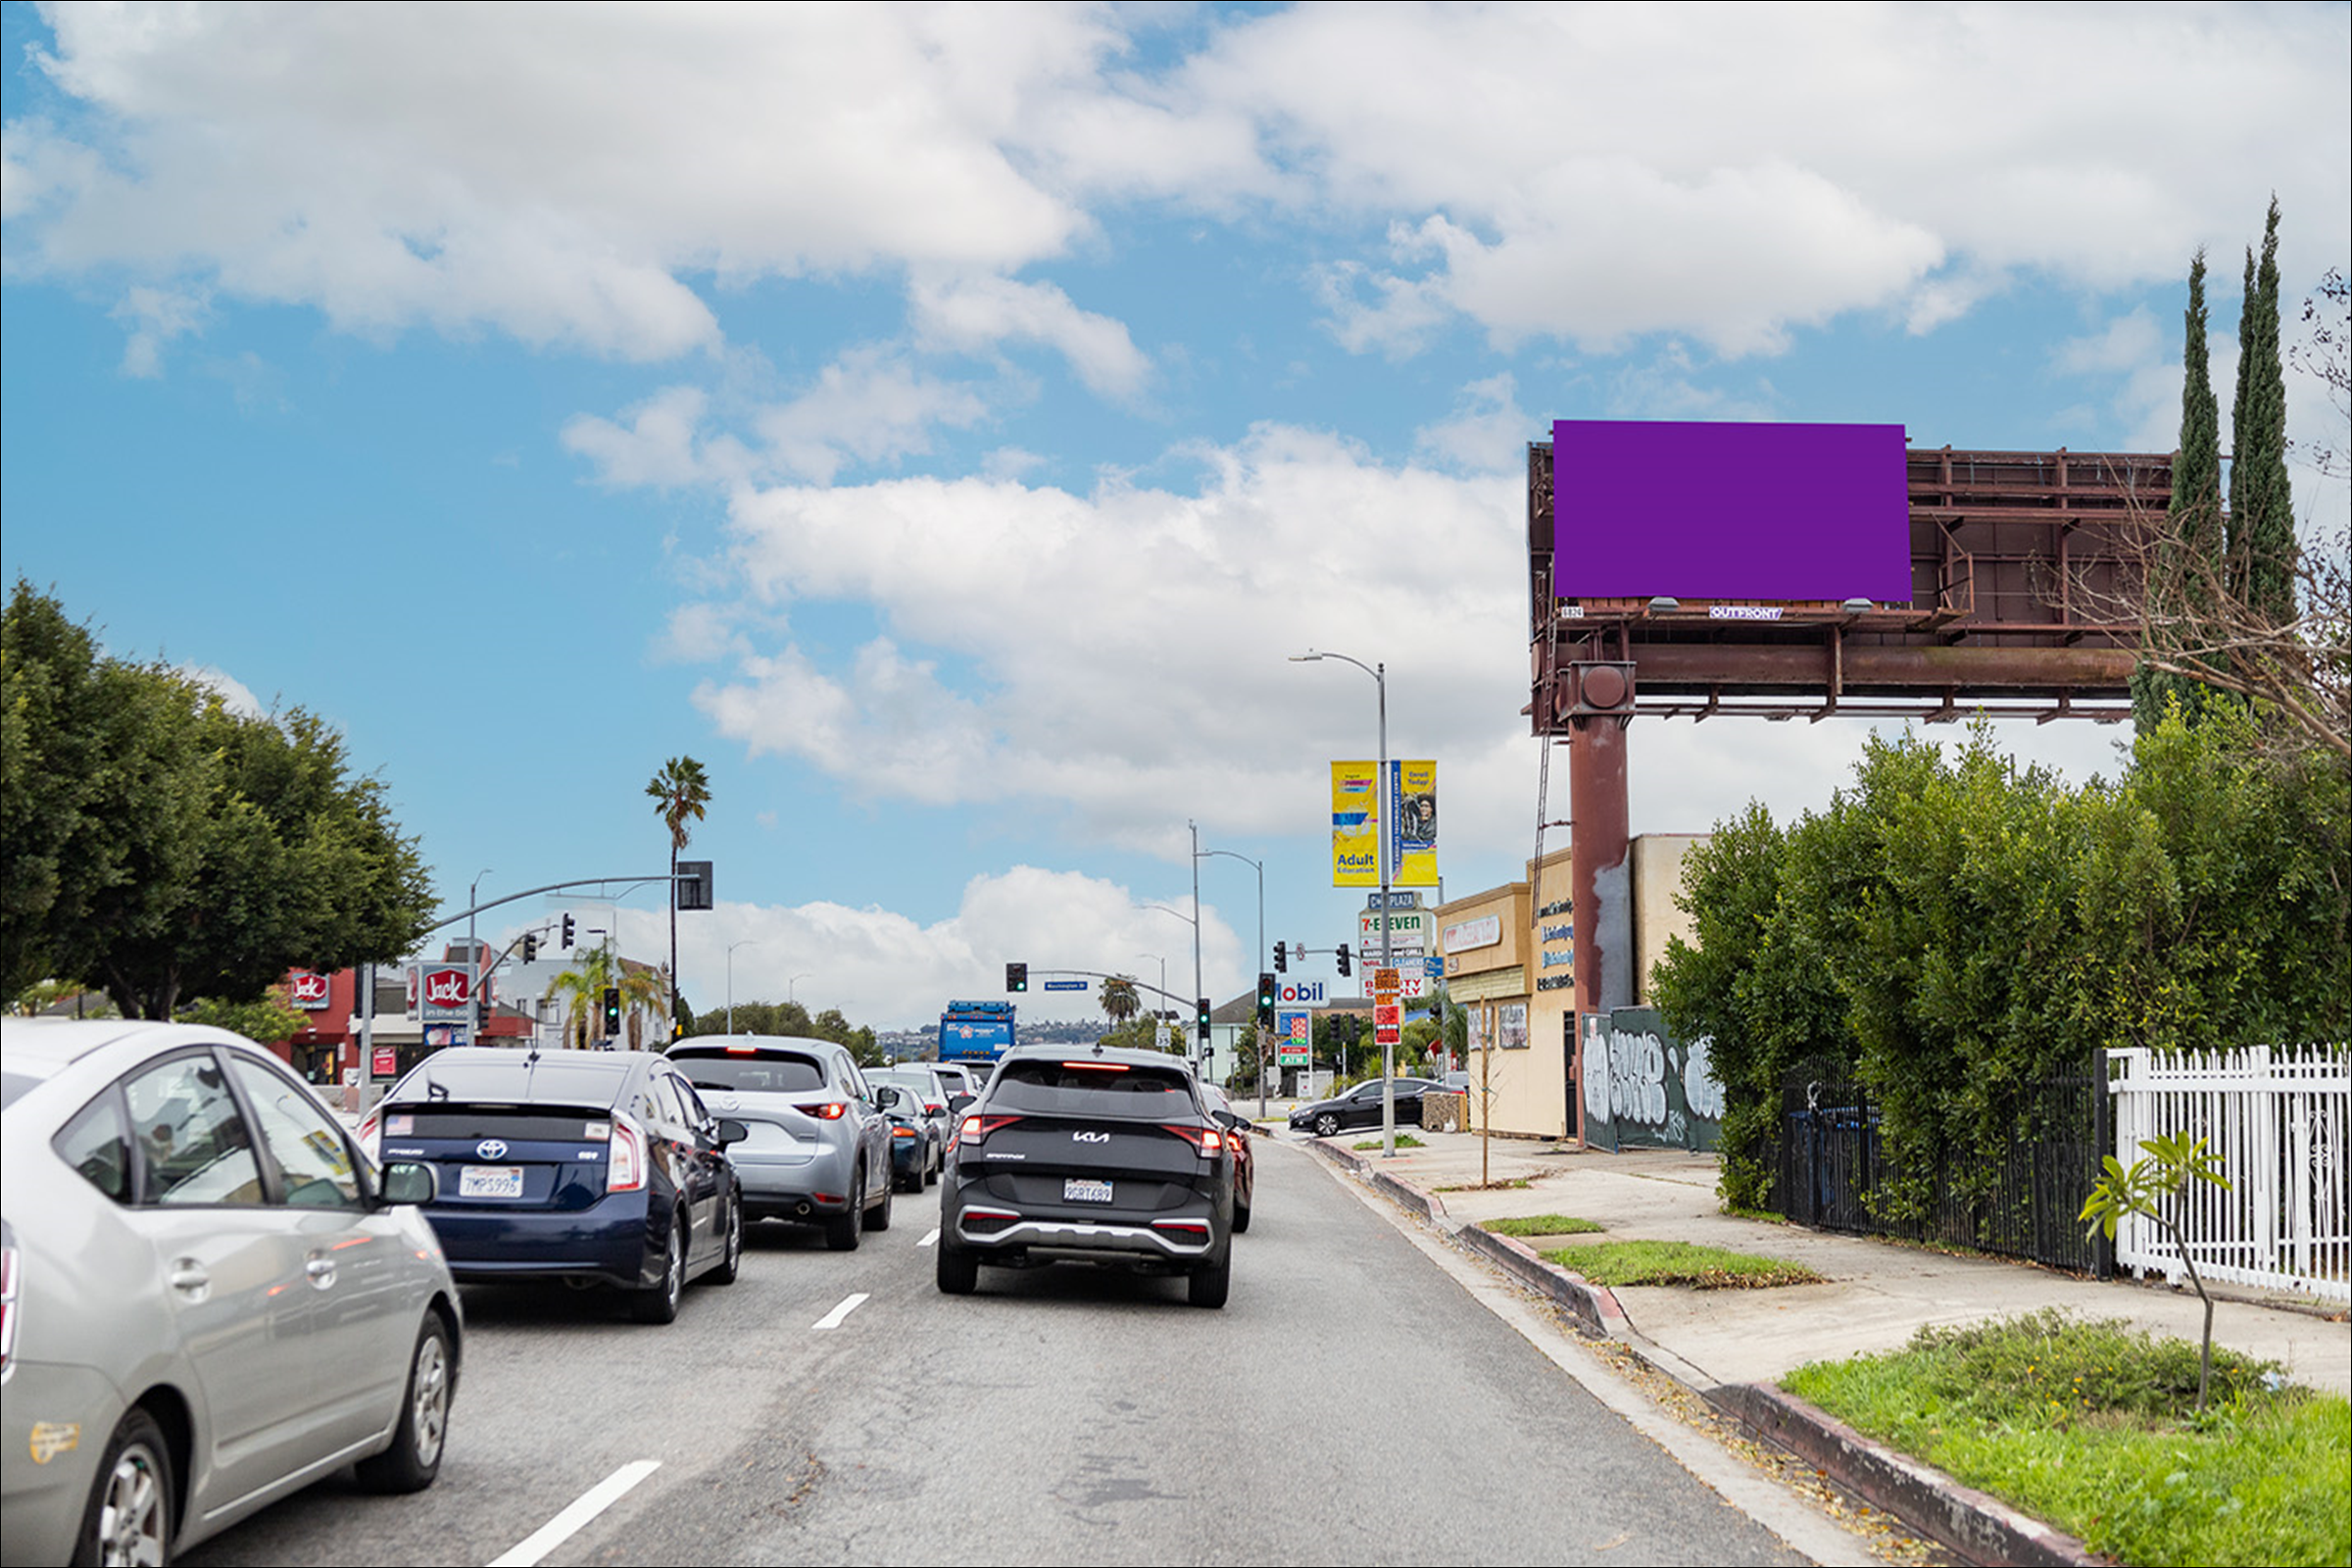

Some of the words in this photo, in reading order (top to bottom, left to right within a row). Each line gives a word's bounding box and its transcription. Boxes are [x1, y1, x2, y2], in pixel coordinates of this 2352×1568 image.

[1337, 854, 1374, 865] Adult
[294, 977, 326, 997] Jack
[426, 973, 470, 1002] Jack
[425, 1007, 435, 1016] in
[437, 1007, 454, 1016] the
[455, 1007, 469, 1016] bo
